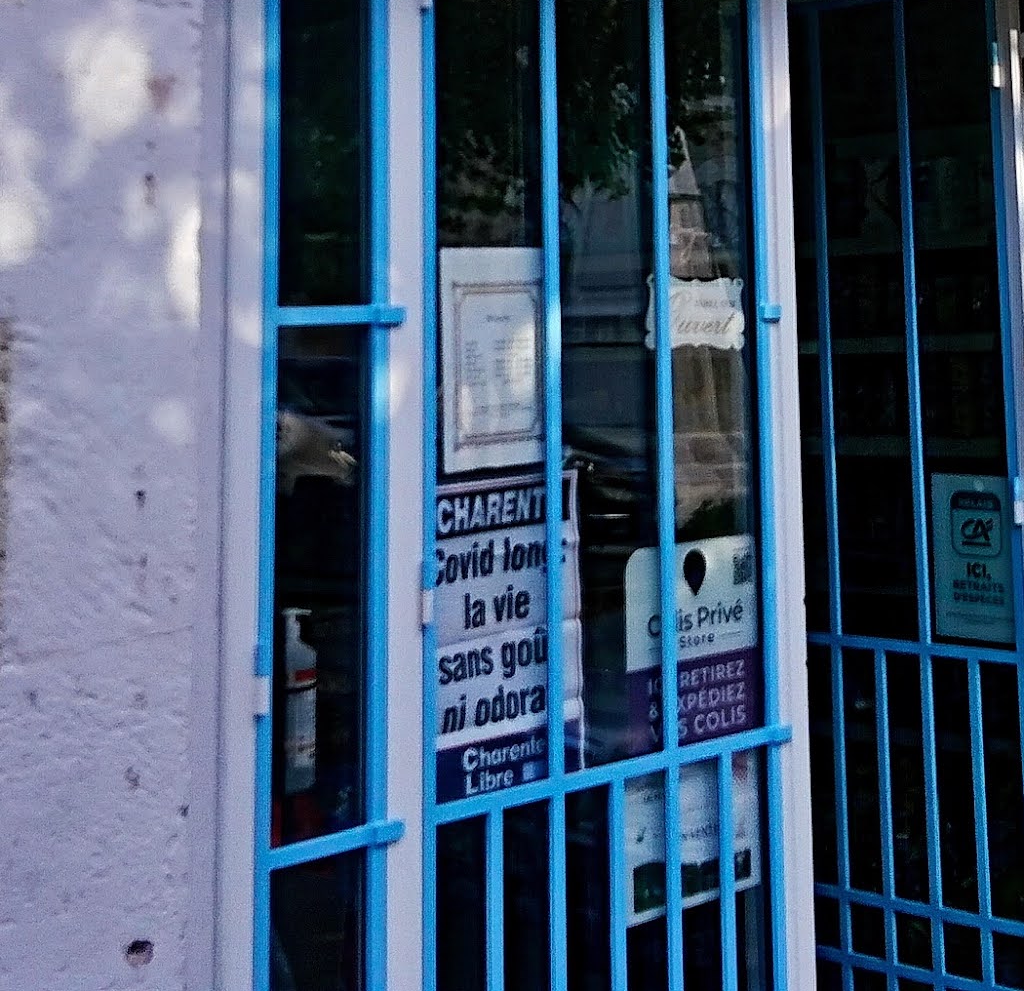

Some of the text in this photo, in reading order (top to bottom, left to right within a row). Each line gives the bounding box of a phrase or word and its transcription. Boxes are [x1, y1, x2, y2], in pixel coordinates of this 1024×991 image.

[436, 488, 547, 534] CHARENT
[464, 584, 531, 629] la vie
[647, 598, 744, 638] Cis Privé
[438, 626, 549, 686] sans goû
[679, 632, 716, 649] Store
[680, 659, 745, 689] RETIREZ
[442, 683, 547, 735] ni odora
[676, 681, 746, 713] XPÉDIEZ
[693, 704, 747, 737] COLIS
[465, 768, 515, 795] Libre
